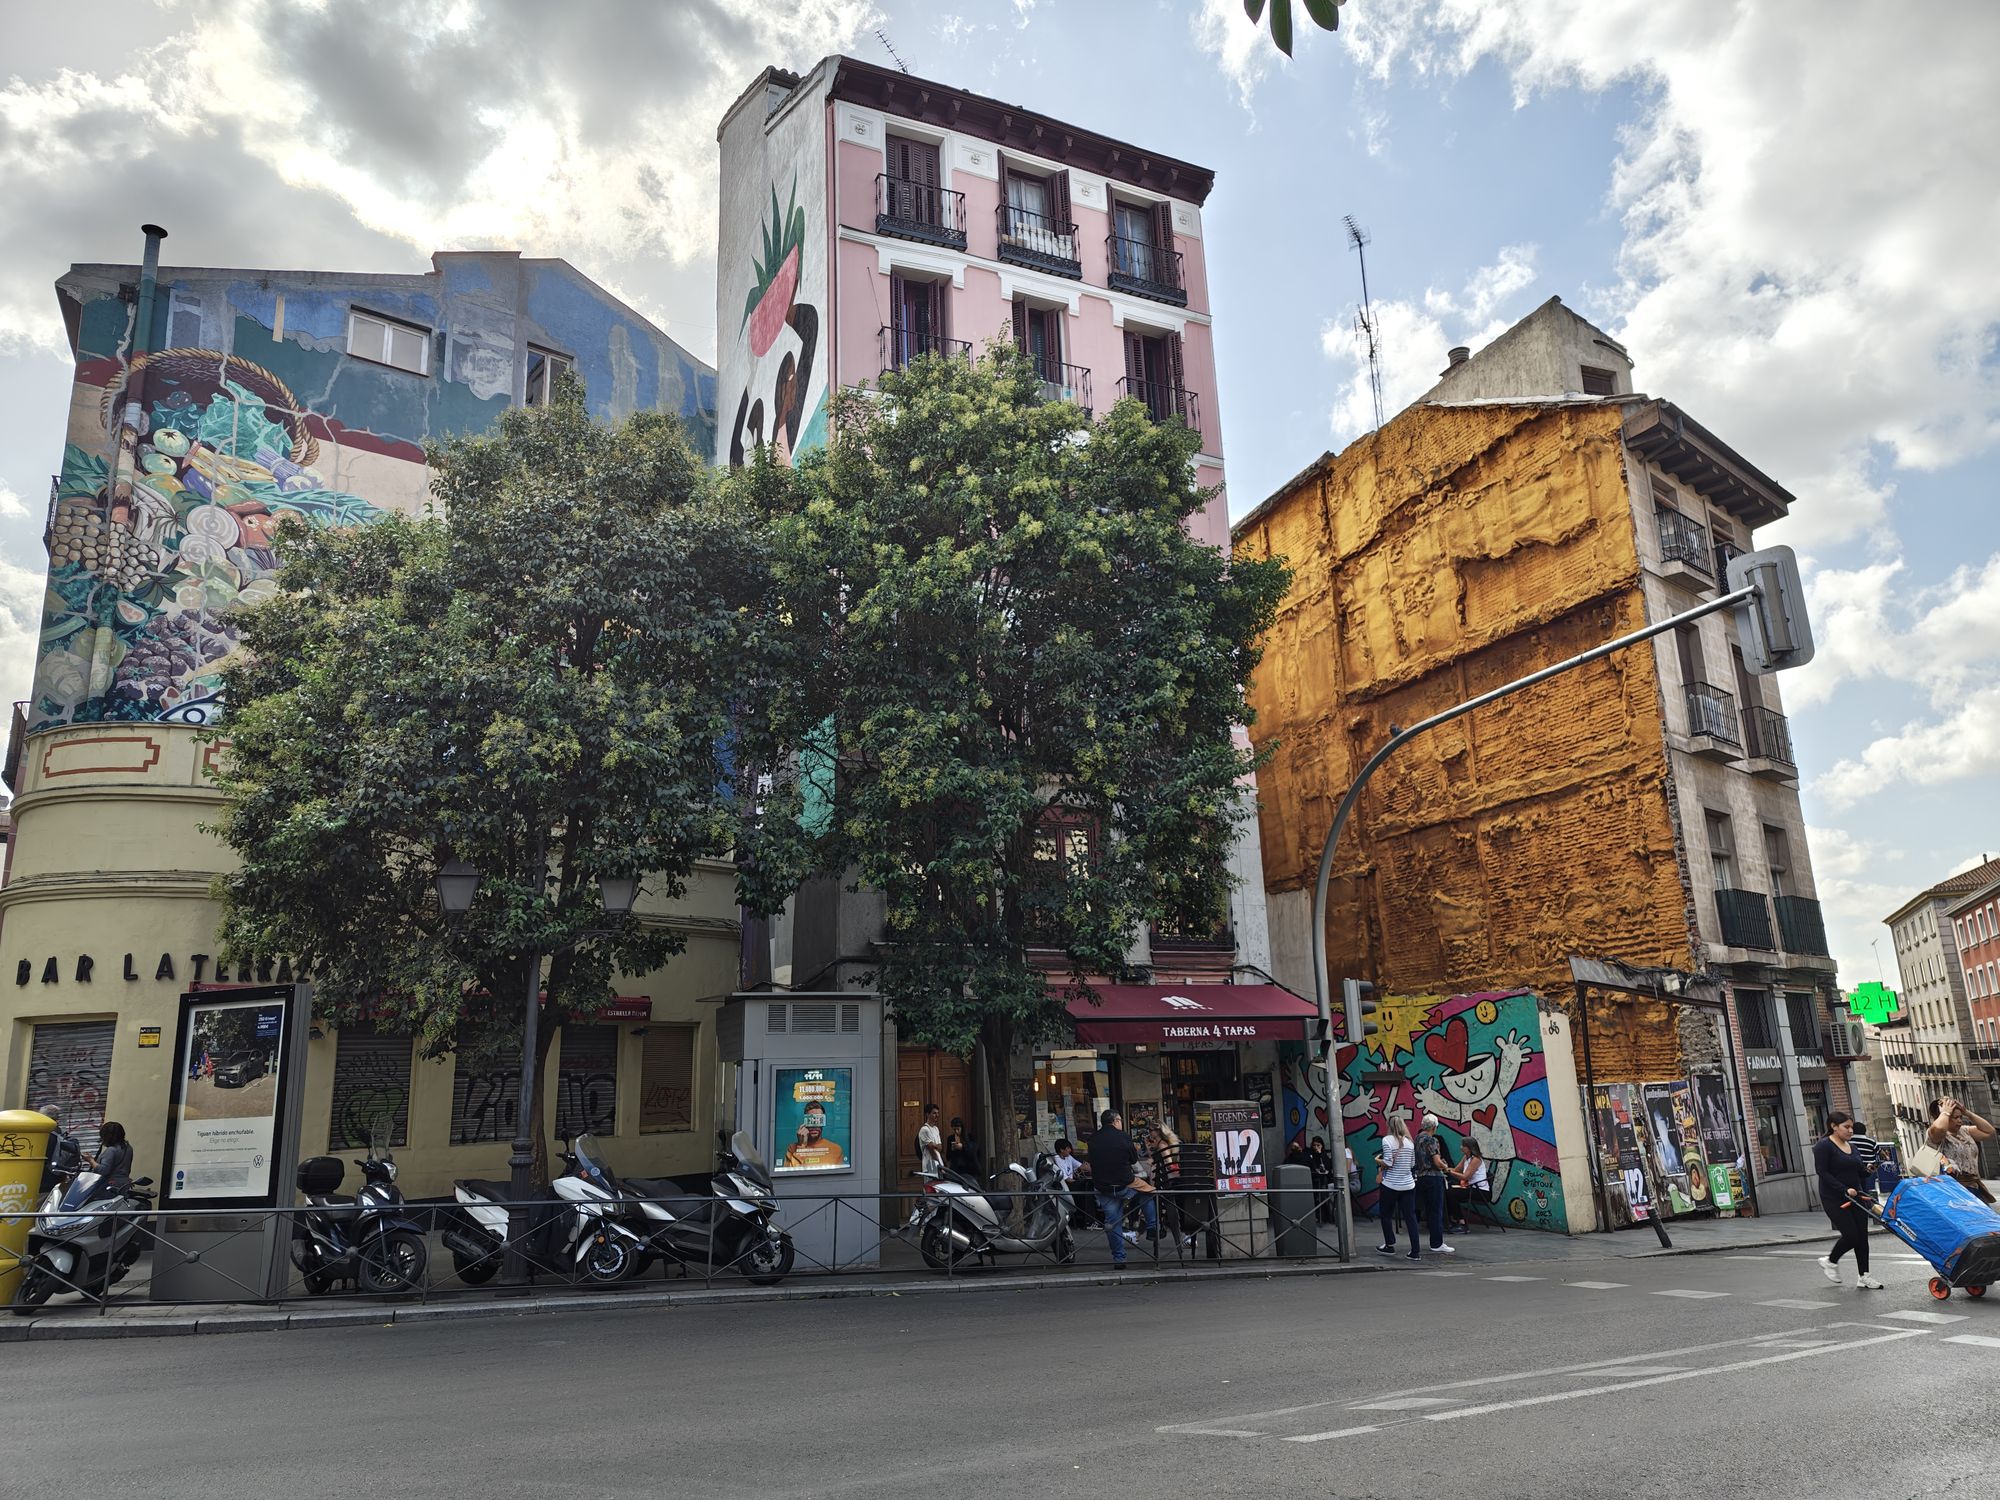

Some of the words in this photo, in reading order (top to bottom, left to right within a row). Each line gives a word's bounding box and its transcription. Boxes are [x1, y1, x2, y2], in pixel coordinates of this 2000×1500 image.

[16, 953, 94, 986] BAR
[1852, 995, 1873, 1011] 12
[1878, 994, 1892, 1009] H
[1163, 1026, 1210, 1037] TABERNA
[1213, 1025, 1221, 1037] 4
[1223, 1025, 1256, 1036] TAPAS
[1746, 1055, 1782, 1070] FARMACIA
[1795, 1055, 1826, 1068] FARMACIA
[1213, 1112, 1248, 1123] LEGENDS
[1215, 1129, 1261, 1176] U2
